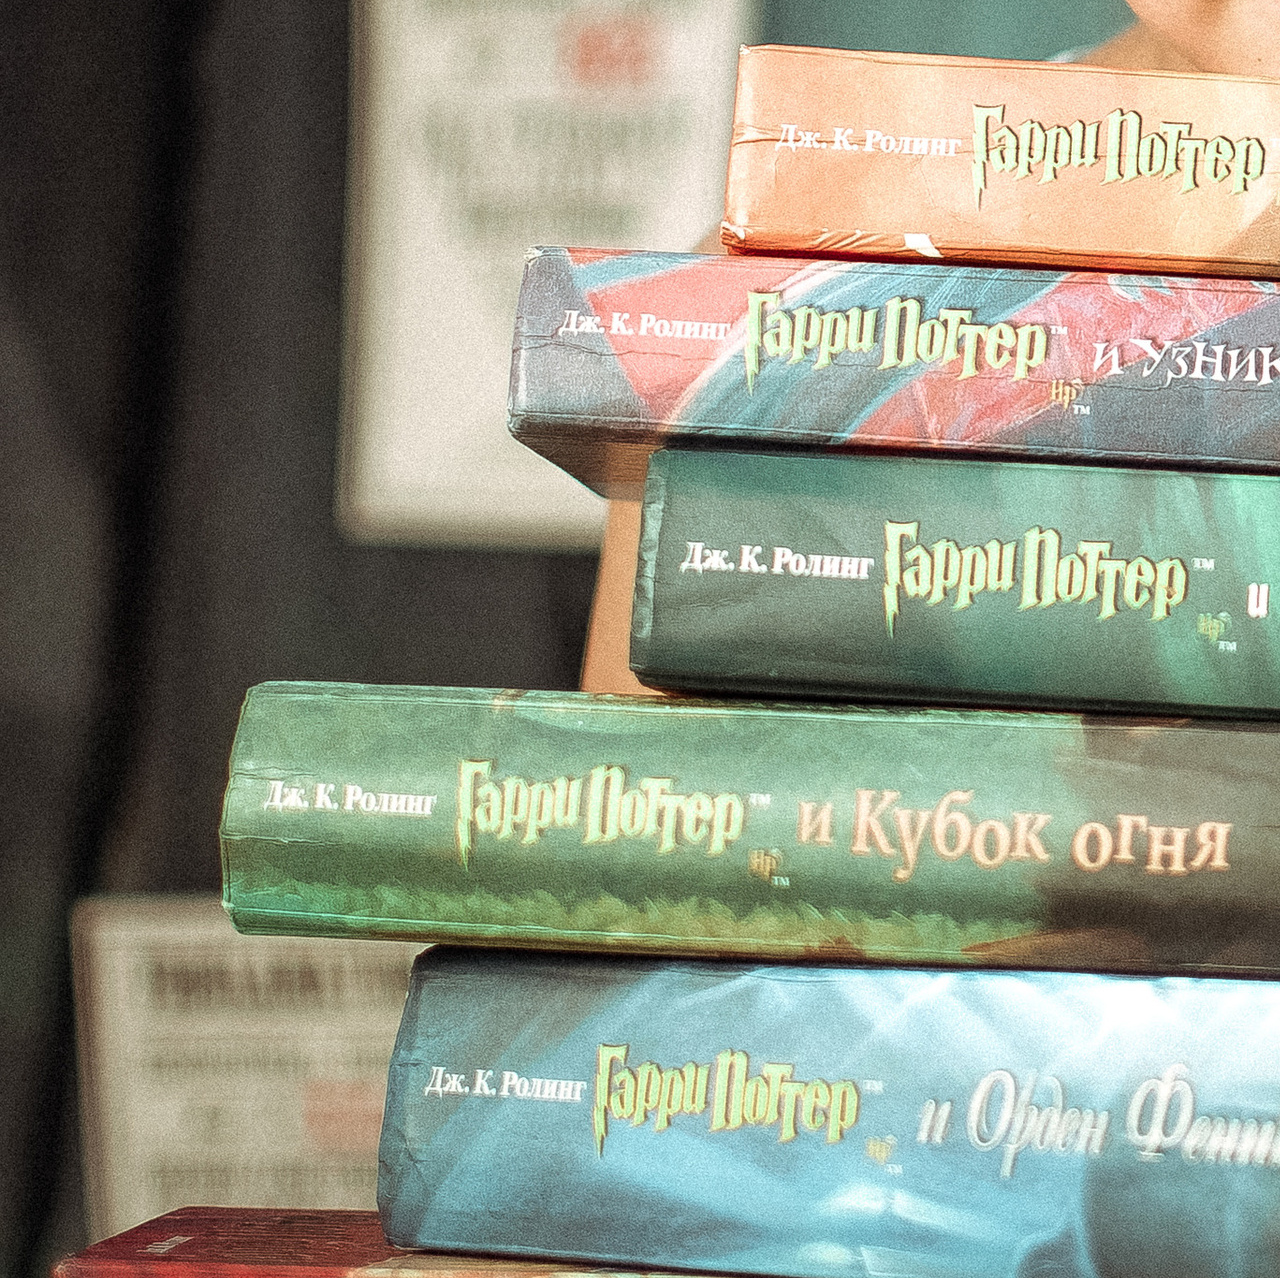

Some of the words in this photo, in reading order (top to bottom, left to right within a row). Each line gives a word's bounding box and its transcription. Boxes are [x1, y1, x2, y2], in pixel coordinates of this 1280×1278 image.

[775, 123, 829, 154] Дж.
[833, 127, 859, 152] К.
[865, 128, 961, 157] Ролинг
[972, 103, 1099, 211] Гарри
[558, 308, 604, 339] Дж.
[609, 312, 634, 337] К.
[640, 313, 728, 342] Ролинг
[744, 288, 875, 396] Гарри
[679, 541, 735, 573] Дж.
[739, 545, 767, 573] К.
[772, 546, 875, 581] Ролинг
[882, 519, 1016, 640] Гарри
[263, 780, 309, 811] Дж.
[314, 783, 339, 810] К.
[344, 784, 438, 817] Ролинг
[456, 758, 583, 872] Гарри
[796, 799, 833, 846] и
[850, 787, 1052, 882] Кубок
[1069, 811, 1234, 873] огня
[424, 1065, 470, 1096] Дж.
[473, 1069, 497, 1096] К.
[499, 1070, 588, 1103] Ролинг
[593, 1042, 711, 1159] Гарри
[916, 1097, 952, 1146] и
[966, 1067, 1110, 1179] Орден
